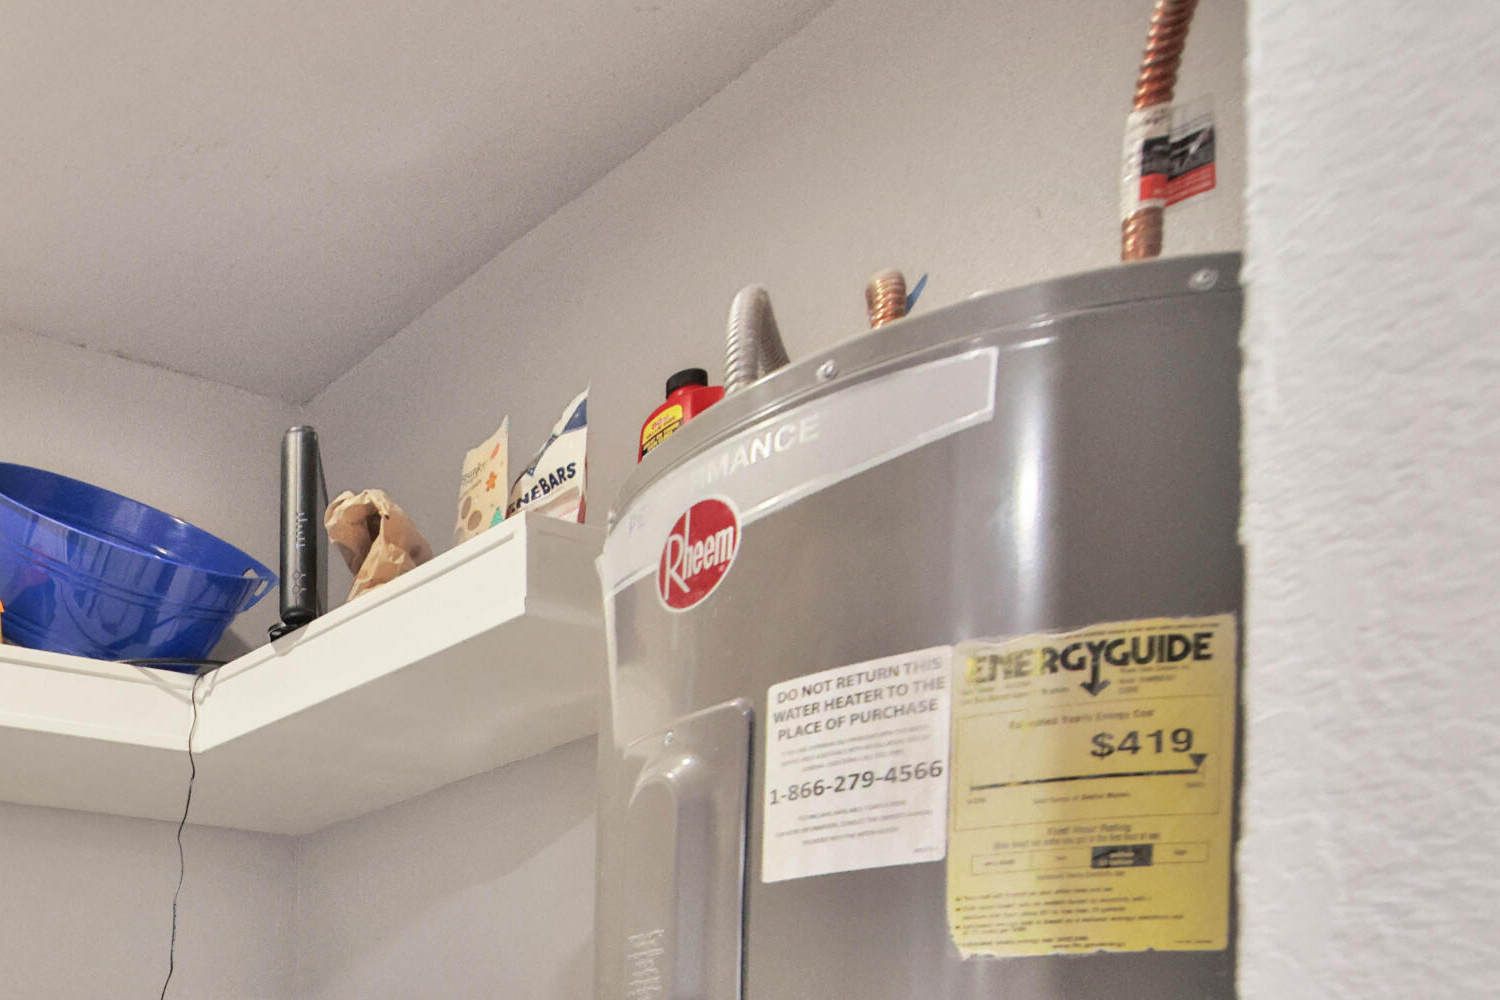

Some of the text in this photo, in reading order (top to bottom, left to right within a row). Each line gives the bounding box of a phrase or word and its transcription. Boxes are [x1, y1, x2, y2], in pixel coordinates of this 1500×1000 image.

[664, 508, 735, 601] Rheem
[773, 703, 826, 724] WATER
[824, 689, 884, 712] HEATER
[887, 685, 909, 700] TO
[909, 676, 947, 694] THE
[777, 657, 943, 704] DO NOT RETURN THIS
[777, 699, 939, 741] PLACE OF PURCHASE
[1091, 728, 1194, 759] $419
[769, 760, 944, 805] 1-866-279-4566
